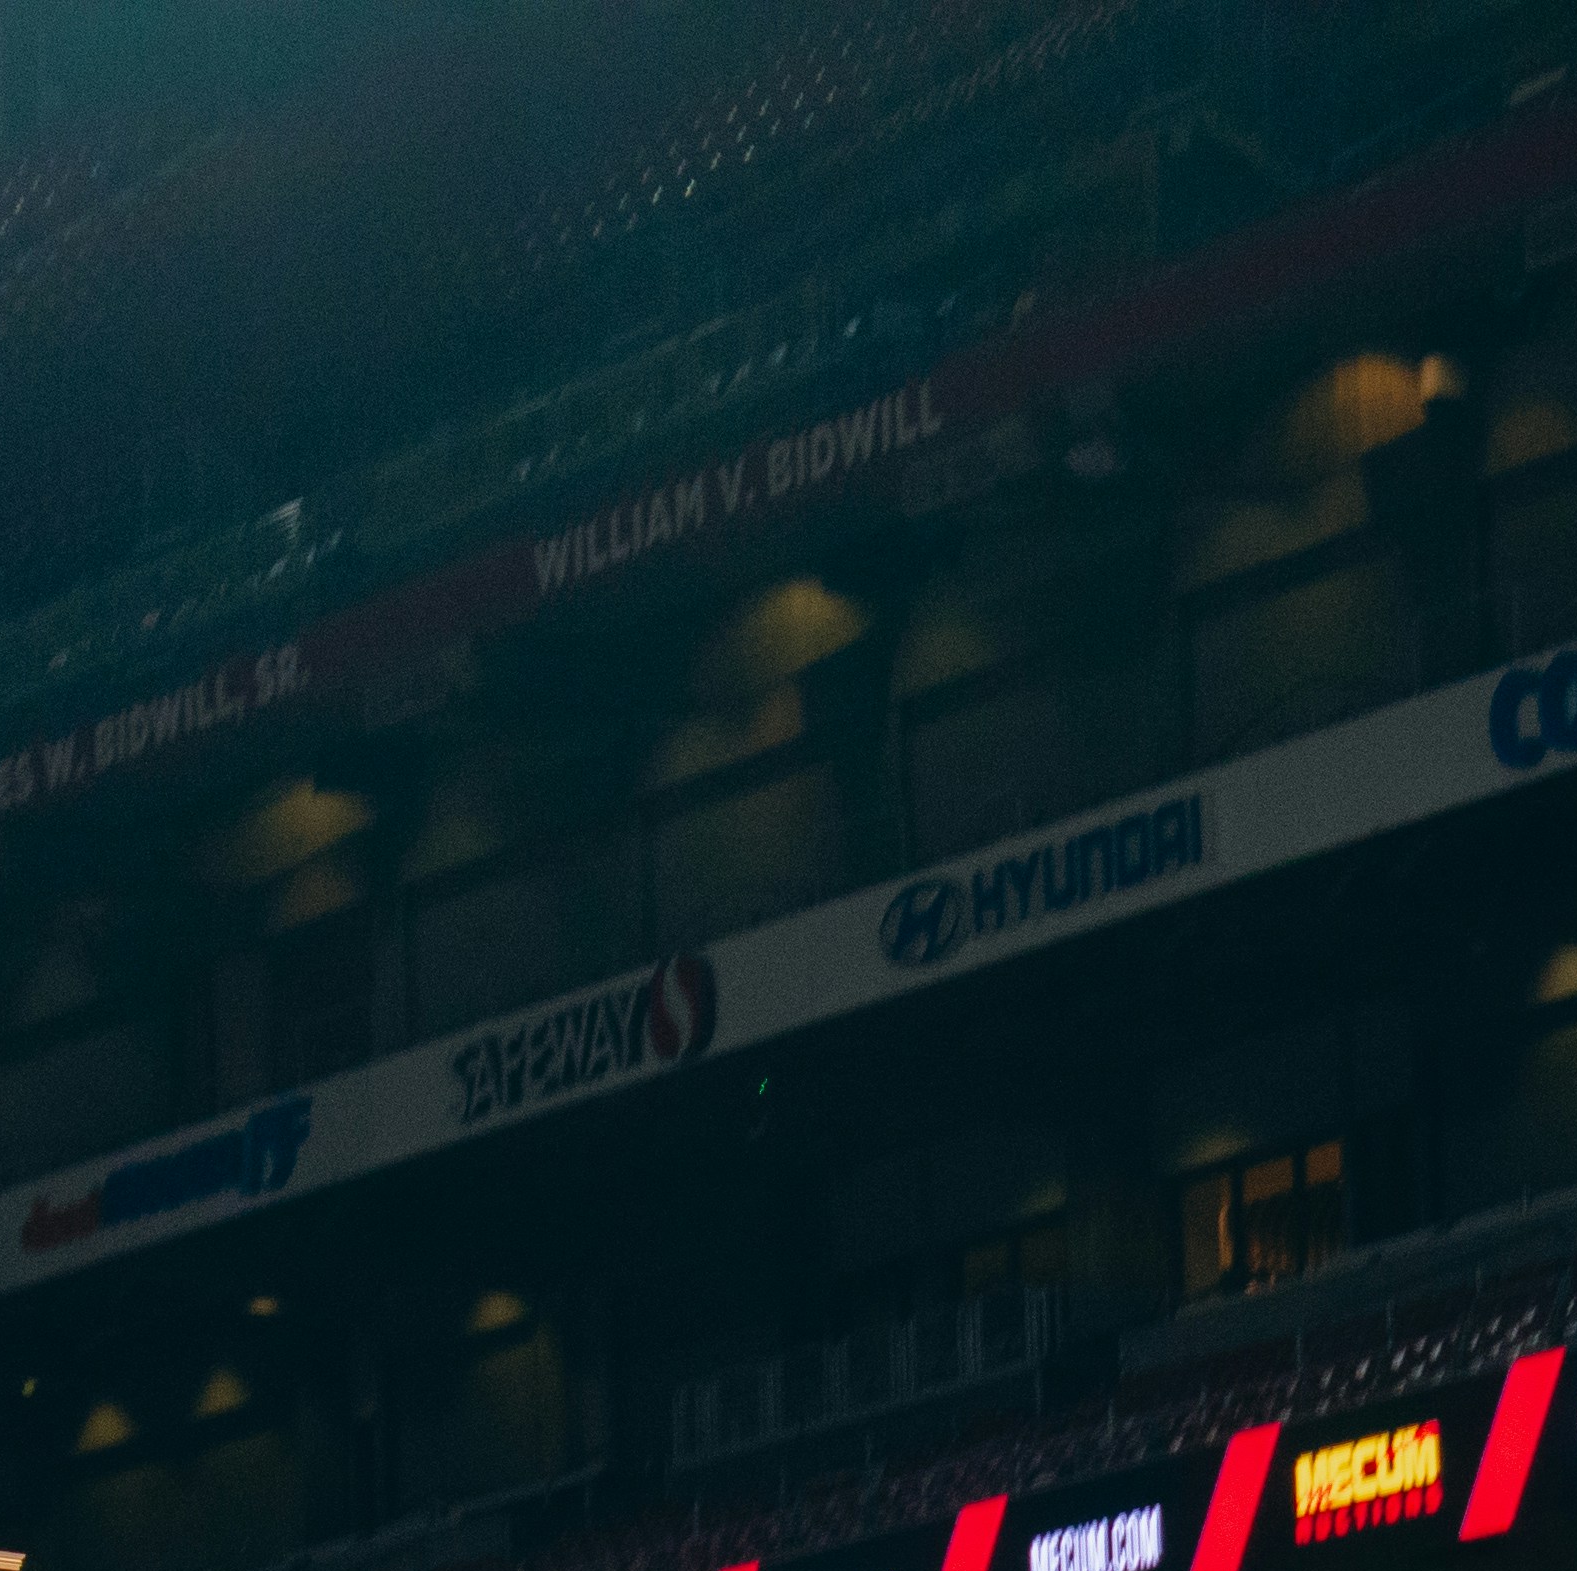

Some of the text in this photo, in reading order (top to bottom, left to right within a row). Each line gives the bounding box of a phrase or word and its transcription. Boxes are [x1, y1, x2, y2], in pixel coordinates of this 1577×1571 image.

[534, 379, 944, 596] WILLIAM V. BIDWILL
[255, 641, 311, 706] SR.
[973, 795, 1202, 936] HYUNDAI
[452, 982, 650, 1124] SAFEWAY
[1294, 1421, 1440, 1518] MECUM
